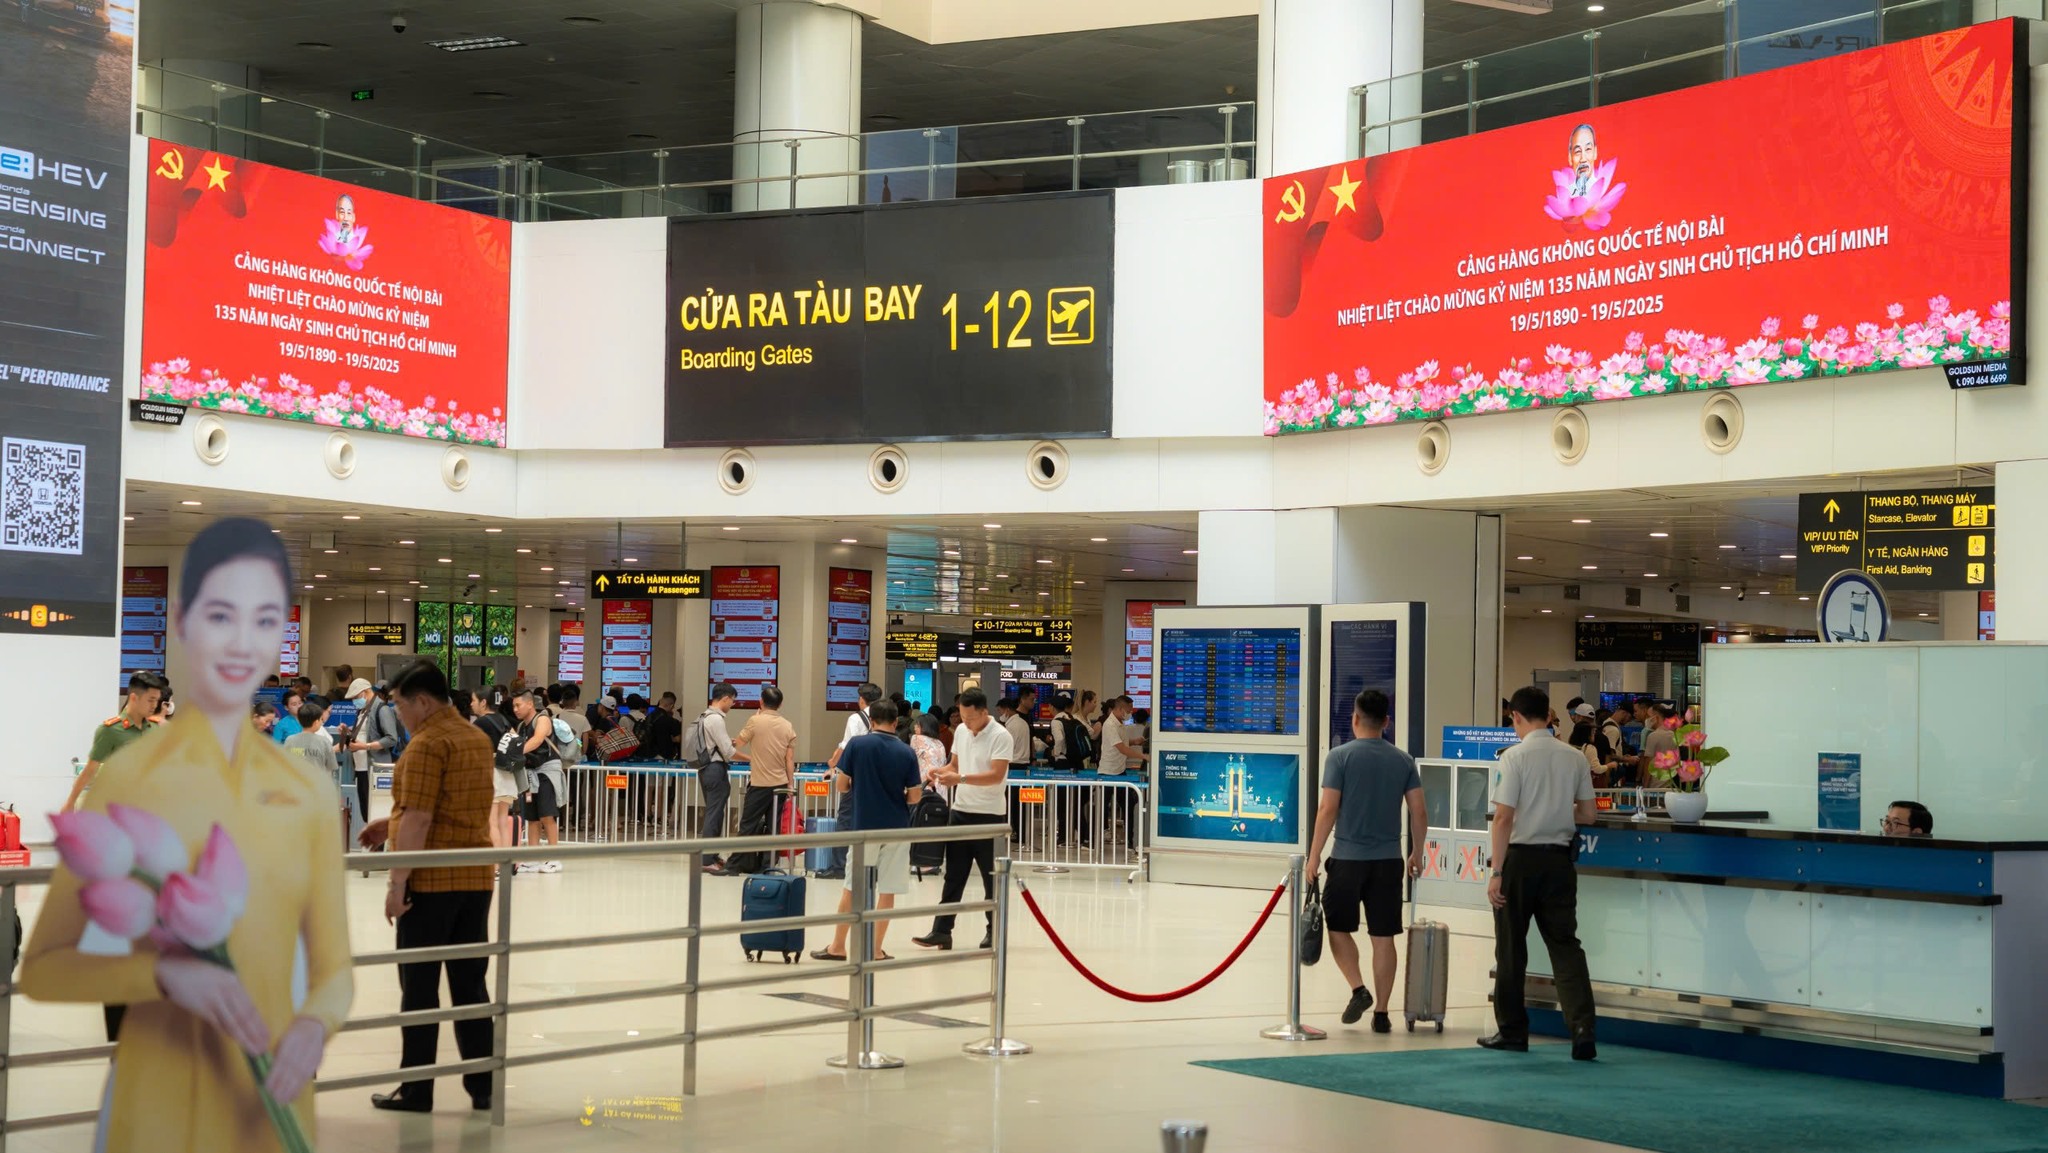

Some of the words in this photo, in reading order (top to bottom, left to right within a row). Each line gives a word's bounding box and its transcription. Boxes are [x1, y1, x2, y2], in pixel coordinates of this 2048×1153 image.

[0, 194, 106, 229] SENSING
[1457, 254, 1496, 277] CẢNG
[1498, 248, 1539, 270] HÀNG
[1542, 239, 1595, 264] KHÔNG
[1598, 226, 1642, 253] QUỐC
[1644, 221, 1664, 247] TẾ
[1666, 219, 1694, 247] NỘI
[1698, 214, 1725, 239] BÀI
[234, 251, 269, 274] CẢNG
[272, 260, 307, 281] HÀNG
[309, 268, 351, 289] KHÔNG
[353, 276, 386, 296] QUỐC
[388, 281, 401, 298] TẾ
[402, 285, 422, 305] NỘI
[424, 289, 442, 306] BÀI
[1337, 303, 1373, 327] NHIỆT
[1376, 299, 1401, 323] LIỆT
[1404, 294, 1441, 316] CHÀO
[1443, 288, 1486, 311] MỪNG
[1488, 280, 1506, 304] KỶ
[1509, 277, 1544, 303] NIỆM
[1548, 275, 1573, 295] 135
[1576, 268, 1610, 291] NĂM
[1614, 260, 1656, 286] NGÀY
[1659, 256, 1696, 279] SINH
[1699, 244, 1733, 272] CHỦ
[1736, 246, 1774, 270] TỊCH
[1778, 233, 1803, 261] HỒ
[1807, 229, 1838, 256] CHÍ
[1840, 225, 1888, 252] MINH
[248, 282, 284, 305] NHIỆT
[287, 289, 311, 310] LIỆT
[313, 295, 346, 313] CHÀO
[348, 300, 384, 320] MỪNG
[386, 305, 400, 323] KỶ
[402, 311, 429, 330] NIỆM
[680, 287, 742, 331] CỬA
[749, 292, 788, 327] RA
[794, 280, 851, 325] TÀU
[864, 284, 923, 322] BAY
[942, 289, 1032, 351] 1-12
[1510, 307, 1578, 332] 19/5/1890
[1590, 295, 1663, 321] 19/5/2025
[215, 304, 237, 321] 135
[239, 307, 269, 326] NĂM
[271, 314, 303, 332] NGÀY
[305, 320, 333, 337] SINH
[336, 323, 360, 342] CHỦ
[361, 329, 387, 348] TỊCH
[408, 337, 426, 353] CHÍ
[428, 340, 457, 358] MINH
[279, 342, 337, 364] 19/5/1890
[346, 352, 400, 373] 19/5/2025
[681, 347, 755, 371] Boarding
[761, 344, 813, 366] Gates
[1949, 365, 1981, 376] GOLDSUN
[1983, 362, 2007, 372] MEDIA
[20, 367, 110, 393] PERFORMANCE
[1962, 377, 1975, 386] 090
[1976, 376, 1989, 385] 464
[1990, 374, 2007, 383] 6699
[1870, 496, 1901, 507] THANG
[1921, 494, 1953, 506] THANG
[1955, 492, 1976, 504] MÁY
[1868, 514, 1904, 523] Starcase,
[1905, 512, 1937, 522] Elevator
[1804, 532, 1821, 541] VIP/
[1839, 529, 1859, 541] TIÊN
[1811, 544, 1825, 553] VIP/
[1826, 544, 1850, 554] Priority
[1868, 549, 1875, 558] Y
[1892, 546, 1920, 558] NGÂN
[1921, 545, 1949, 557] HÀNG
[1867, 565, 1884, 575] First
[1885, 565, 1899, 575] Aid,
[1901, 564, 1932, 575] Banking
[616, 573, 632, 584] TẤT
[633, 573, 645, 584] CẢ
[646, 574, 669, 584] HÀNH
[671, 574, 700, 584] KHÁCH
[647, 586, 657, 594] All
[659, 586, 700, 595] Passengers
[982, 621, 1005, 630] 10-17
[1050, 621, 1064, 629] 4-9
[1050, 633, 1063, 641] 1-3
[1022, 791, 1043, 800] ANHK
[1597, 800, 1611, 808] NHK
[1579, 834, 1599, 854] CV
